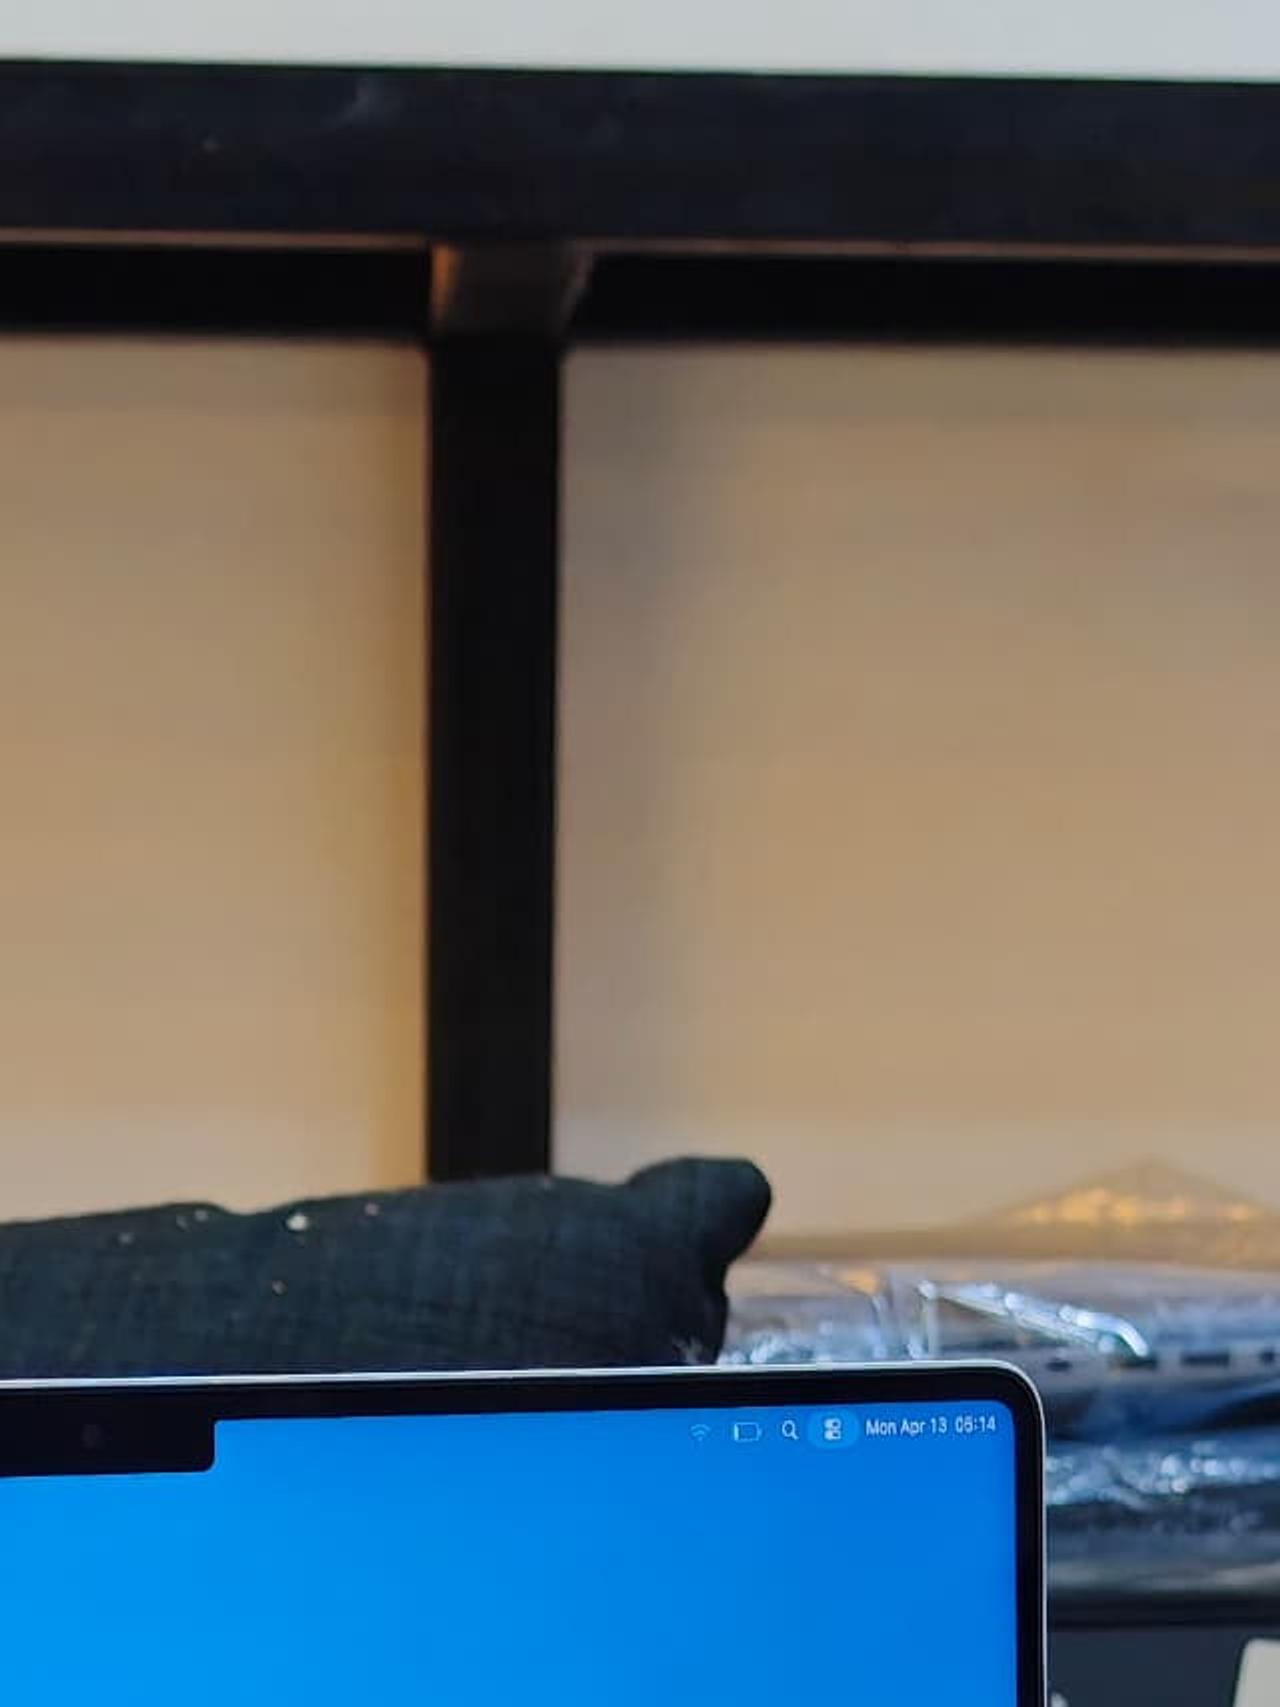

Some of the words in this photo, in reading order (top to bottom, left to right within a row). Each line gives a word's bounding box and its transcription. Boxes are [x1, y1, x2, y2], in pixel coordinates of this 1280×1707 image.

[865, 1418, 898, 1436] Mon
[900, 1417, 927, 1437] Apr
[930, 1416, 948, 1434] 13
